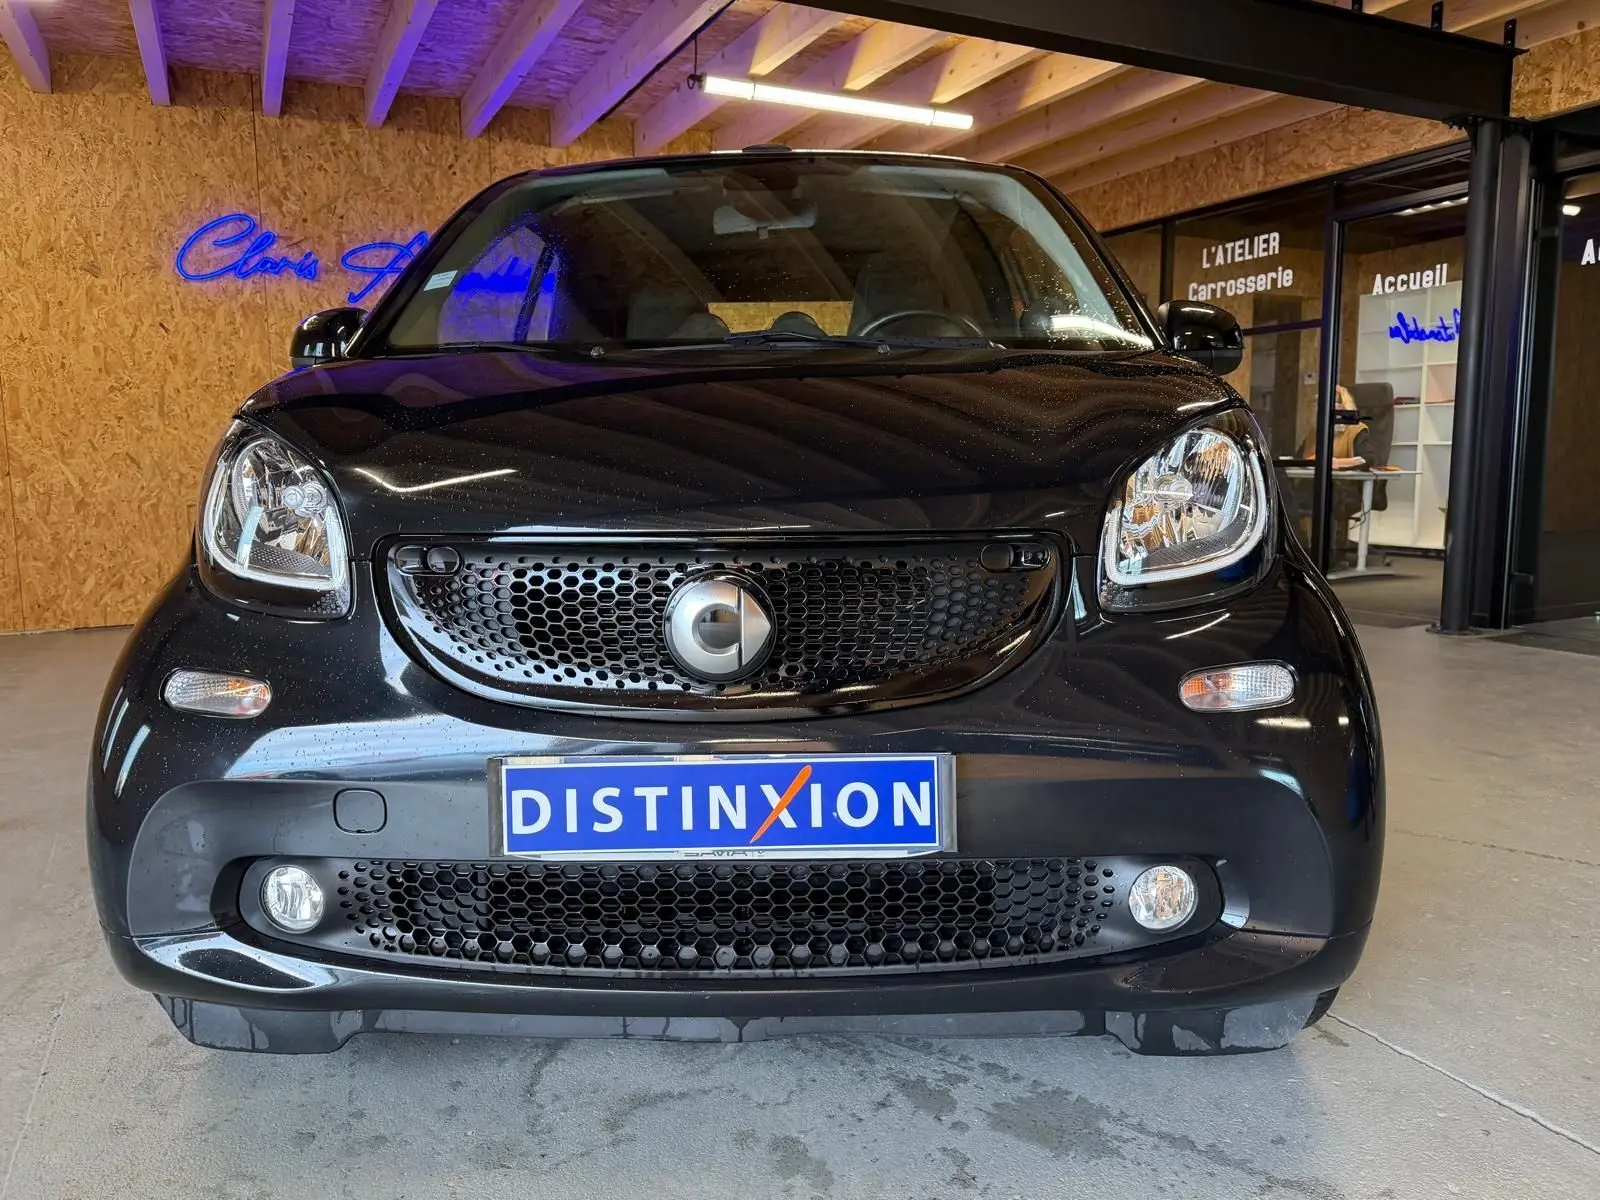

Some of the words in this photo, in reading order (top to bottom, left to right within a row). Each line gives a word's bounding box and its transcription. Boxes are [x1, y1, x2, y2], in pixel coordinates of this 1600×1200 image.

[1202, 231, 1280, 269] L'ATELIER
[1188, 265, 1294, 302] Carrosserie
[1372, 262, 1448, 296] Accueil
[510, 765, 932, 844] DISTINXION
